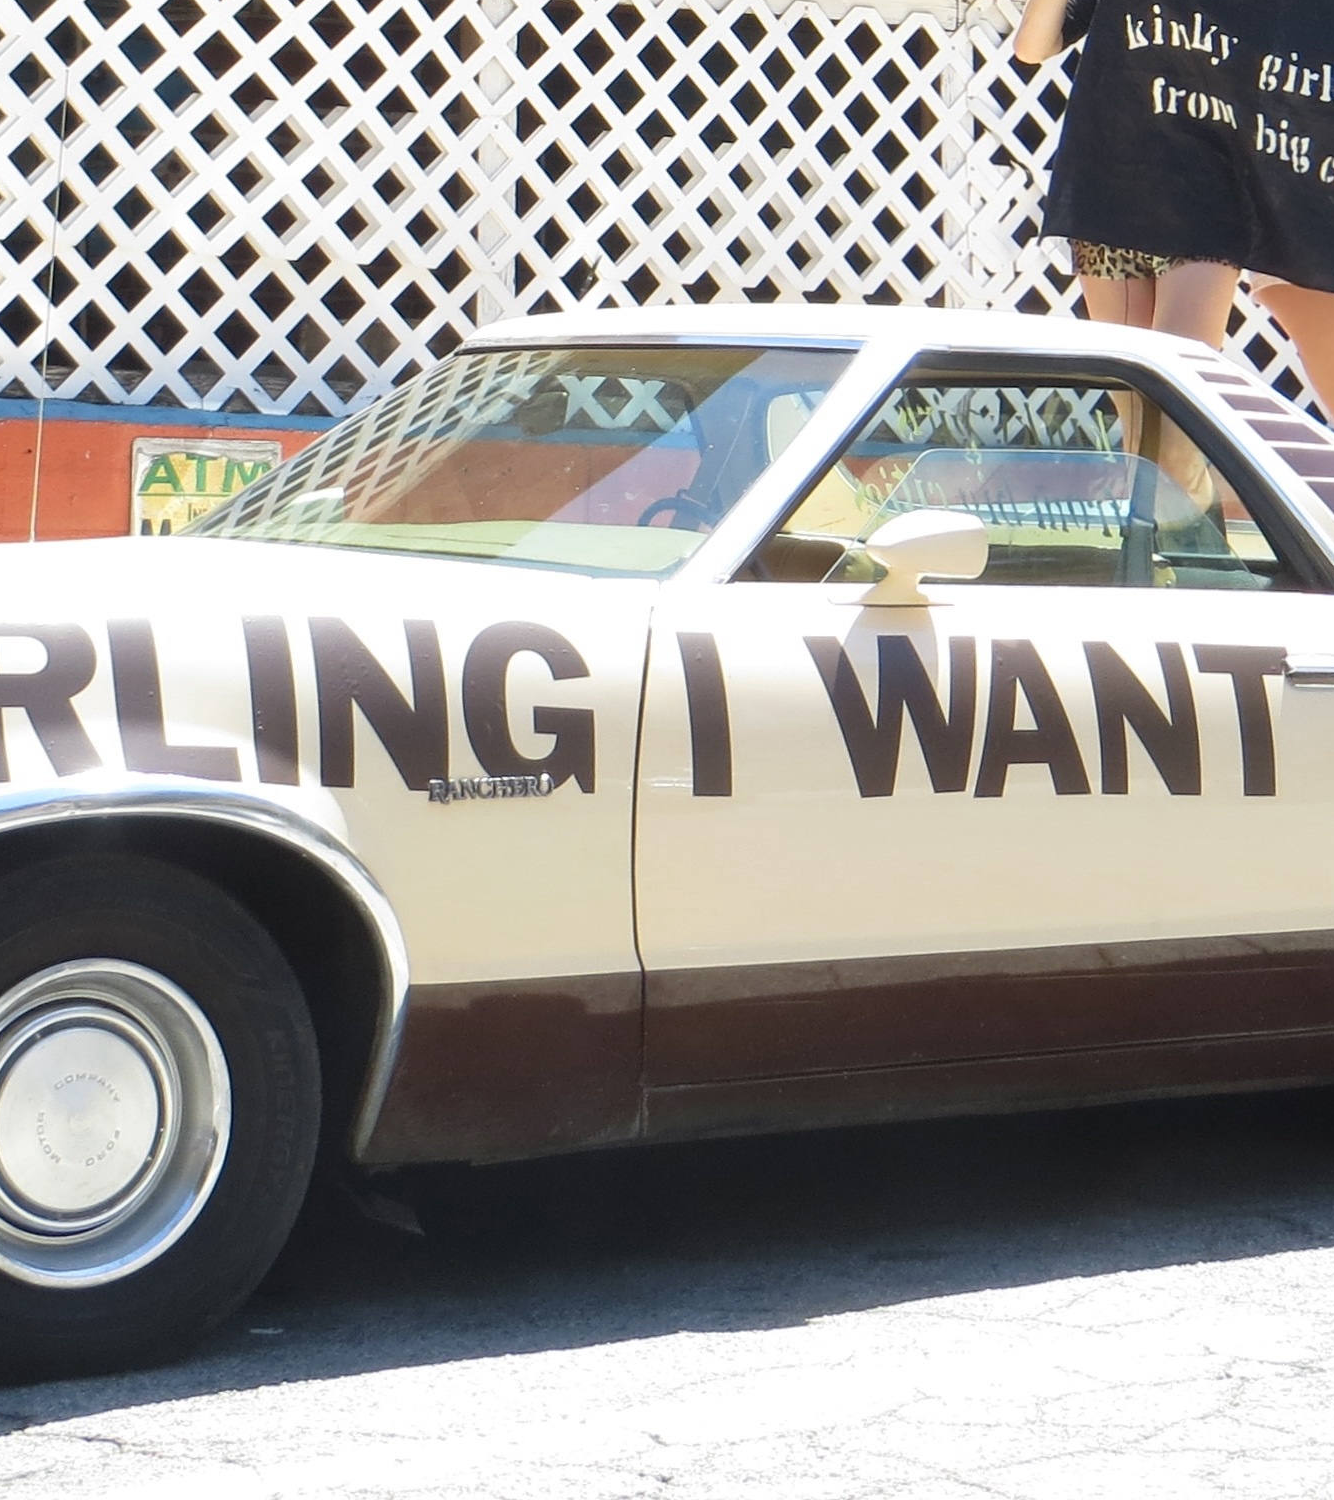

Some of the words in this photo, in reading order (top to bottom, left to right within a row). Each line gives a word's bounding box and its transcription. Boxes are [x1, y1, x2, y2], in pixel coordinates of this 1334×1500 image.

[1125, 4, 1240, 66] kinky
[1152, 77, 1238, 130] from
[1255, 113, 1311, 174] big
[139, 452, 273, 492] ATM
[676, 632, 733, 797] I
[803, 634, 1288, 798] WANT
[428, 771, 556, 805] RANCHERO
